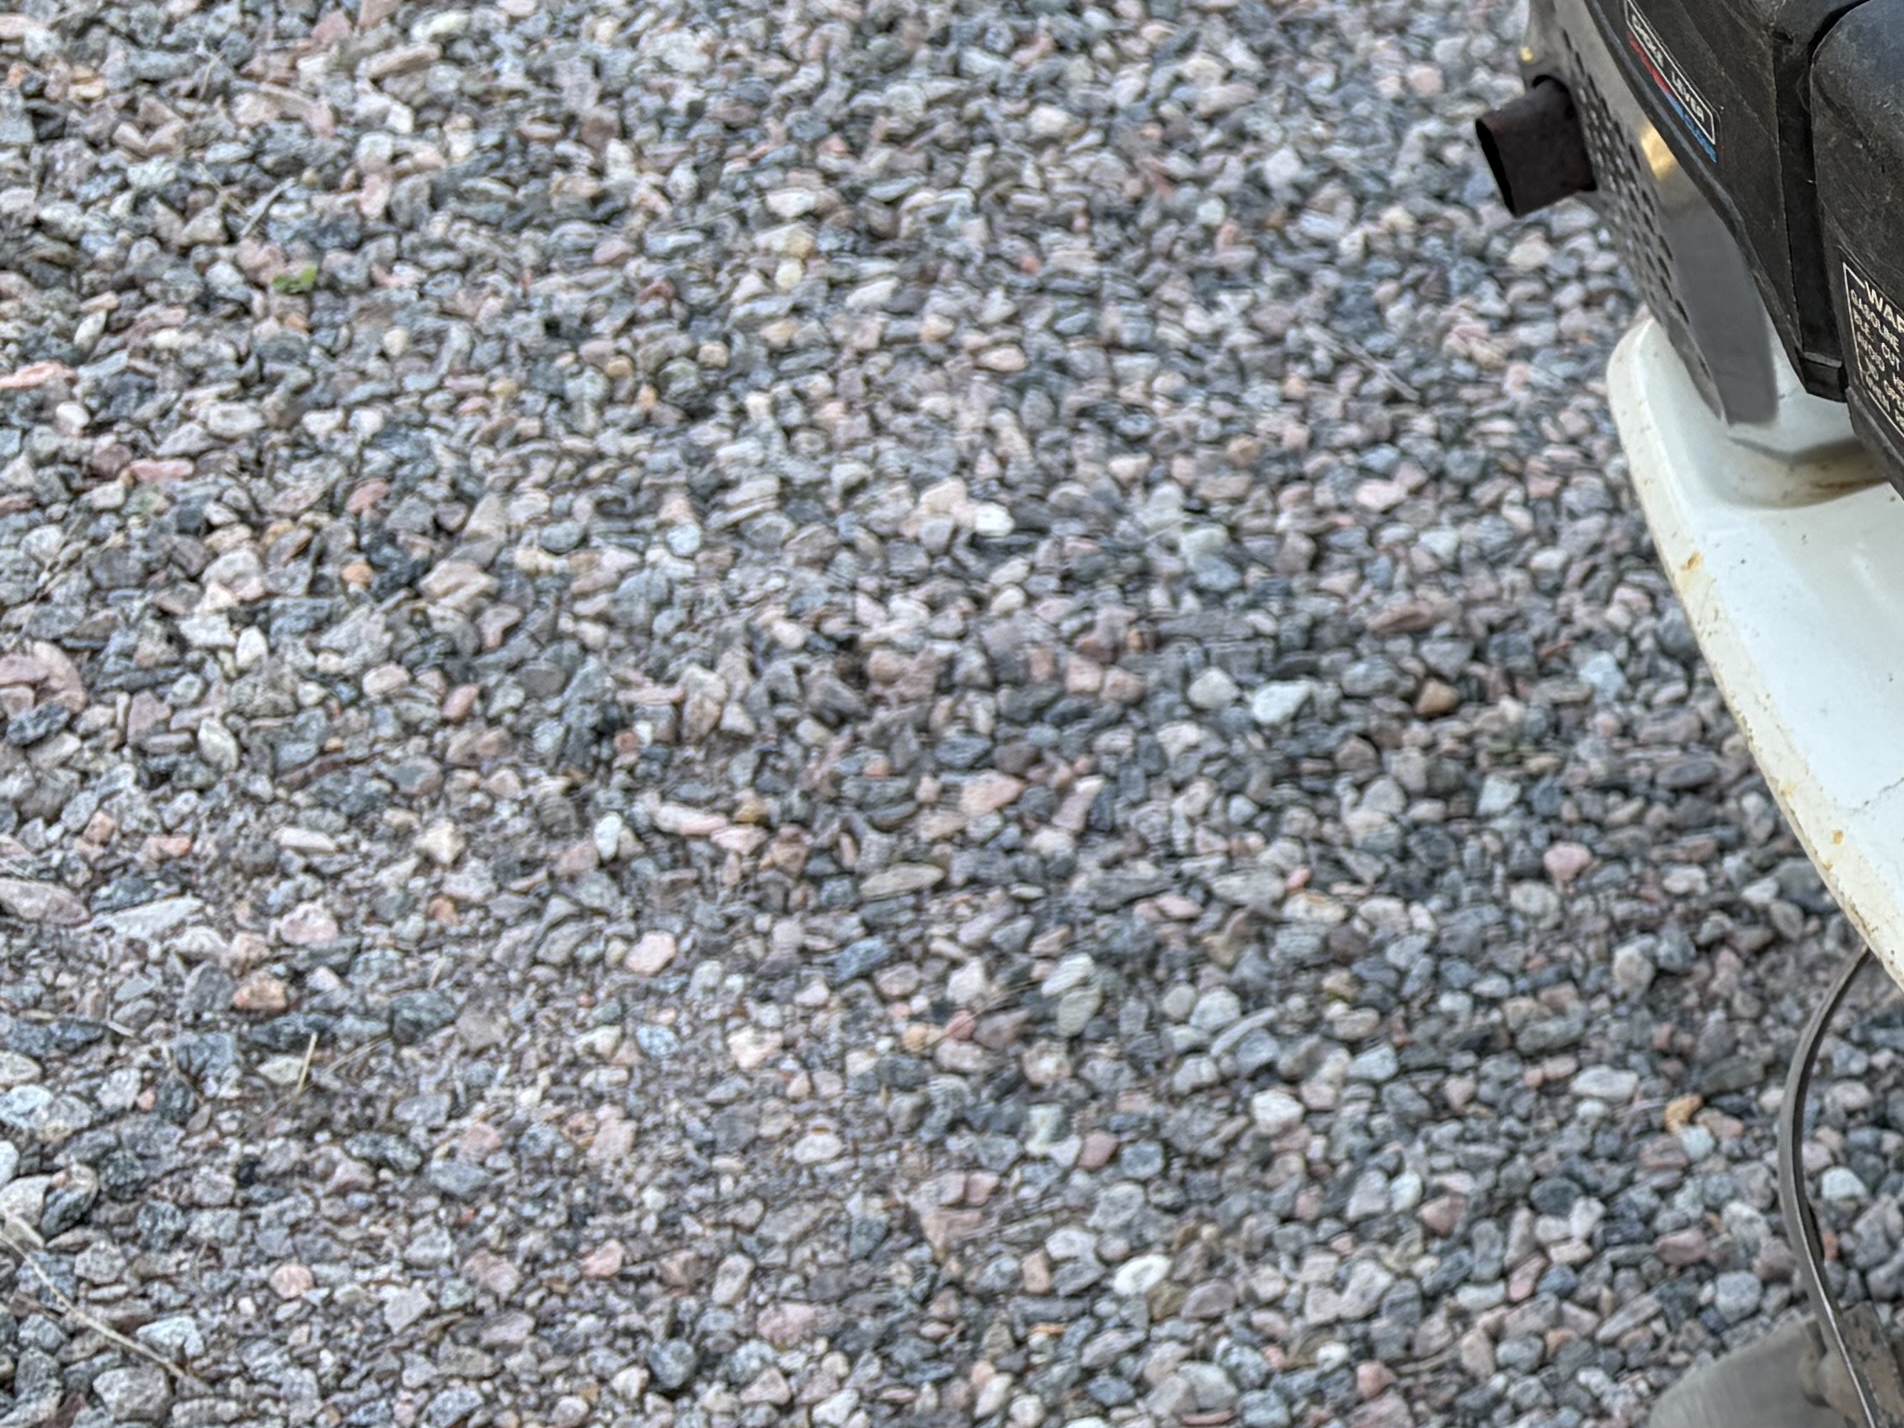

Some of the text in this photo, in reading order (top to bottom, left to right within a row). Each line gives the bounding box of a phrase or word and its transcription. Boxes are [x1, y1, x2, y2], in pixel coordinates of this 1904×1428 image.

[1850, 289, 1899, 352] GASOLINE
[1857, 331, 1885, 371] AVOID
[1881, 342, 1900, 371] CUT
